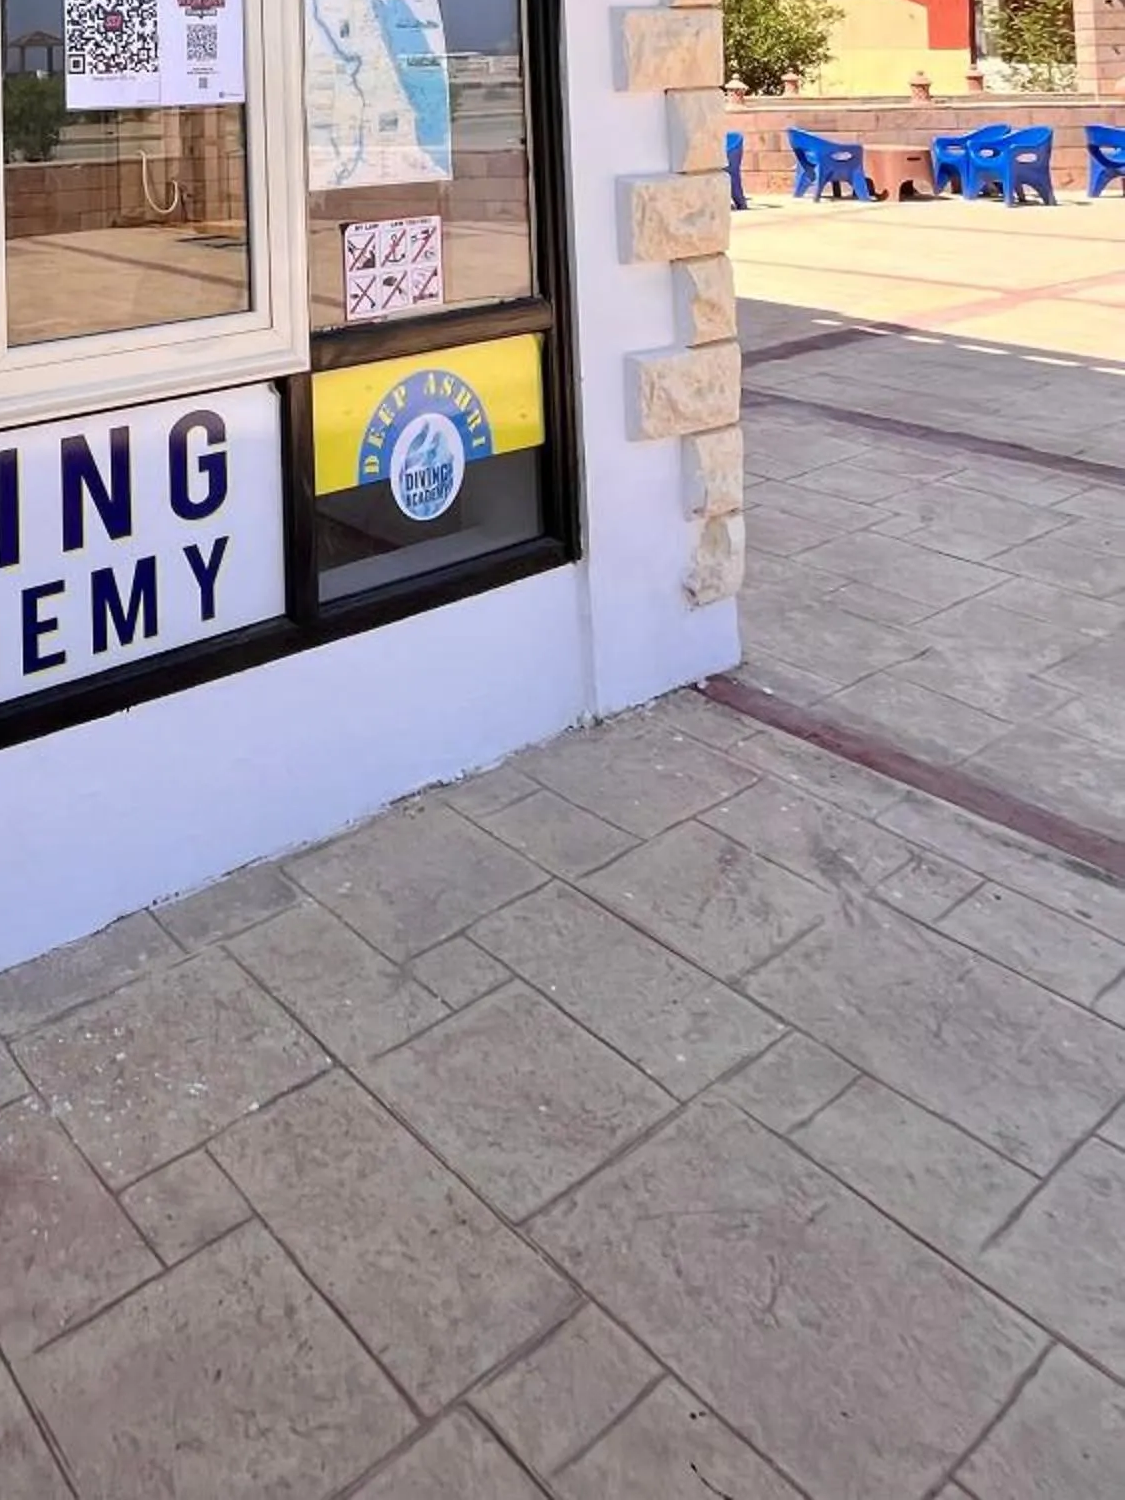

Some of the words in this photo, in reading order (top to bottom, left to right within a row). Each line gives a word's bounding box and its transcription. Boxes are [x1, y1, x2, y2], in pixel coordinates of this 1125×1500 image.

[363, 386, 408, 474] DEEP
[423, 372, 486, 448] ASHRI
[405, 462, 454, 492] DIVING
[406, 481, 454, 508] ACADEMY
